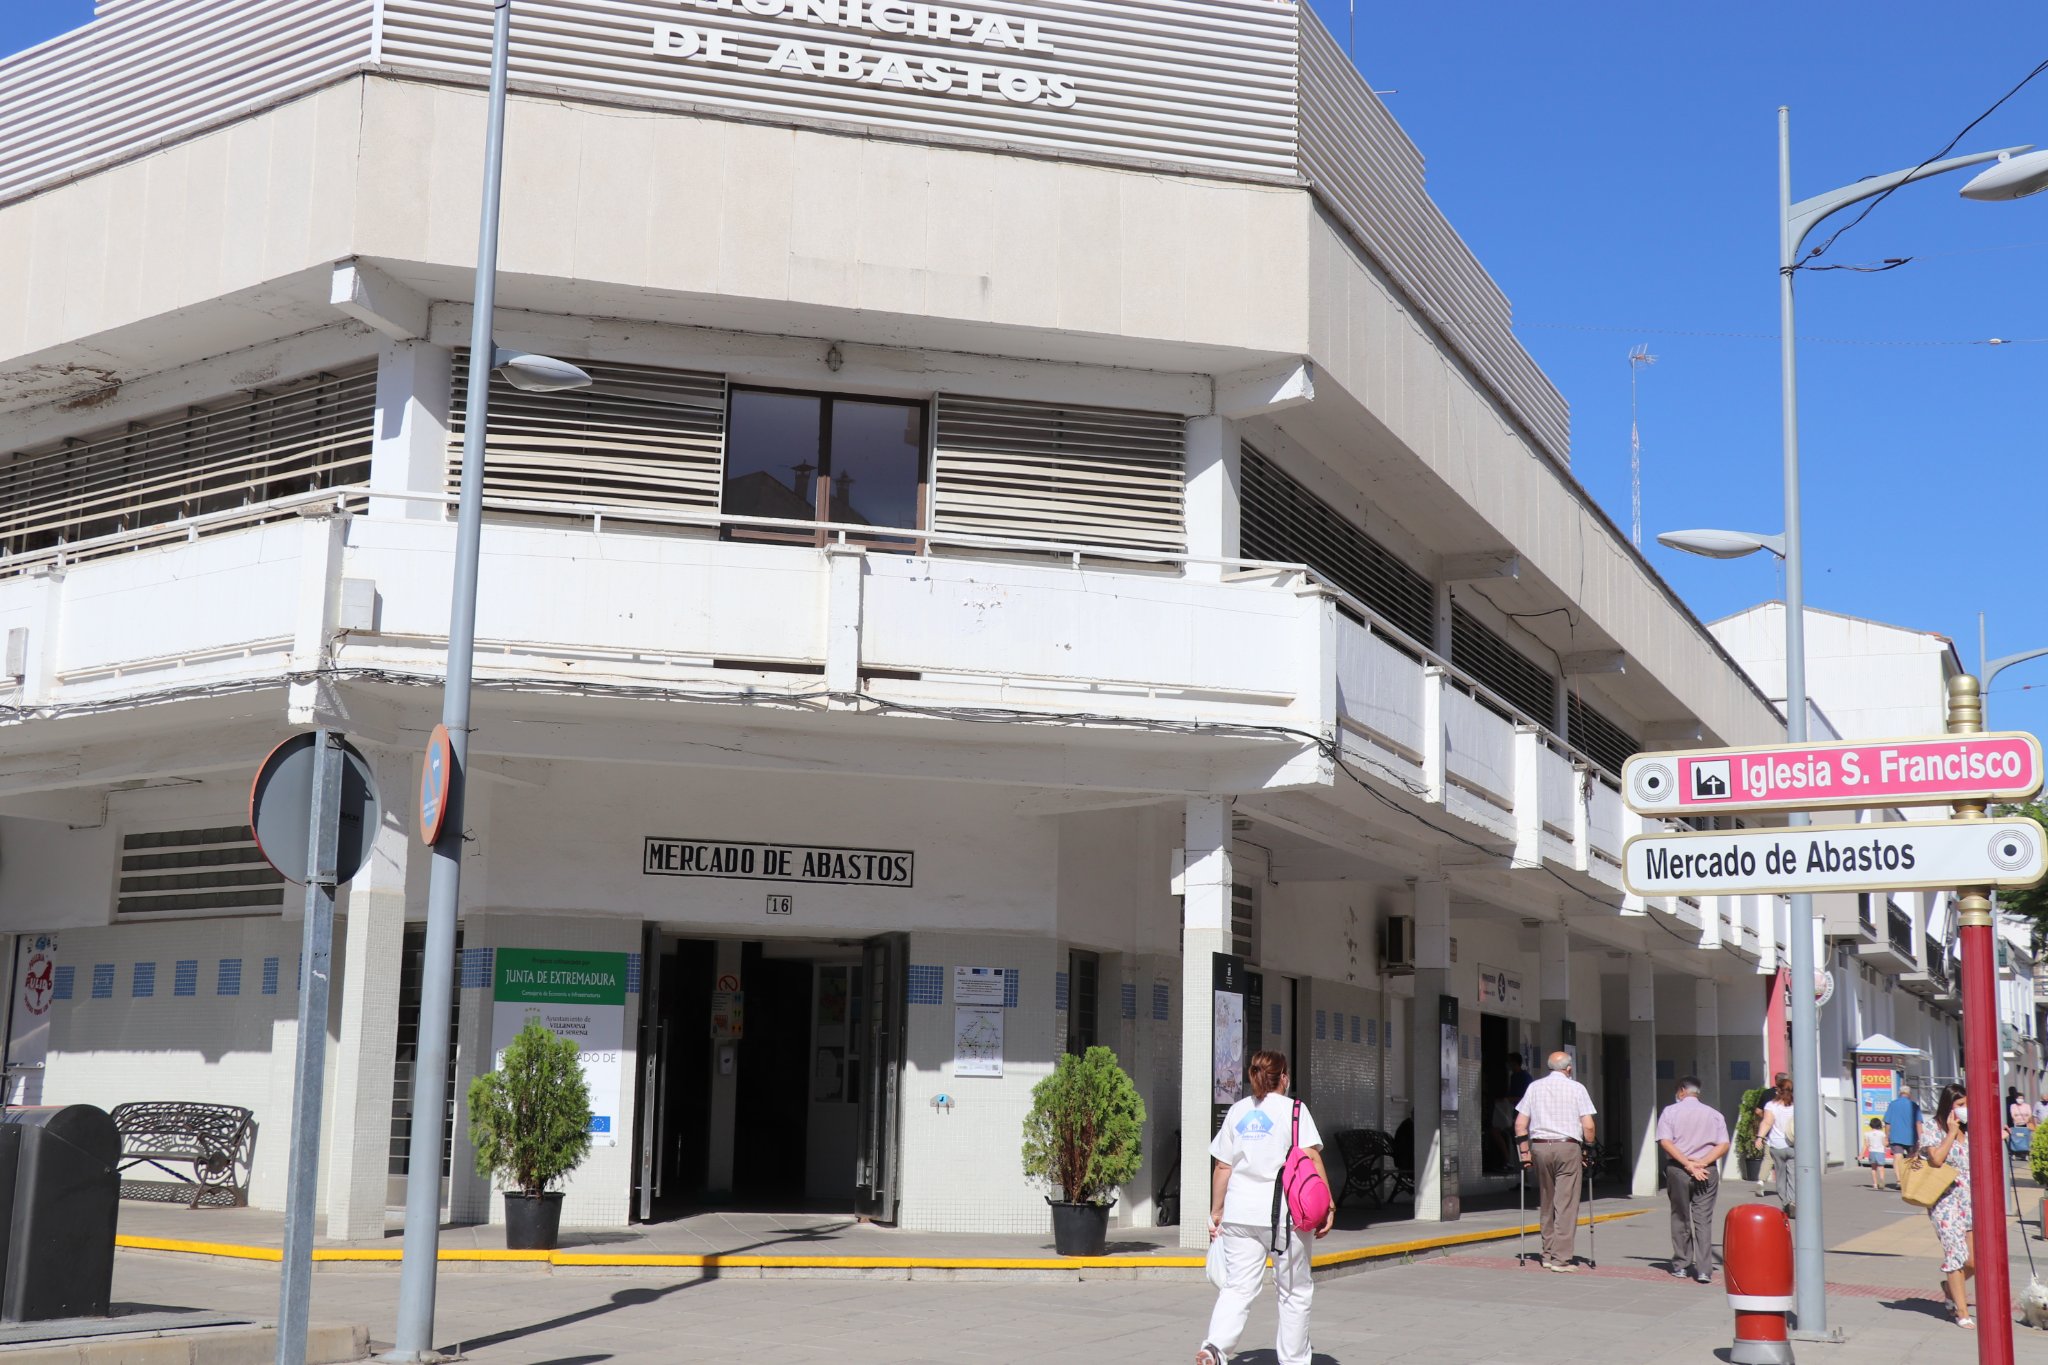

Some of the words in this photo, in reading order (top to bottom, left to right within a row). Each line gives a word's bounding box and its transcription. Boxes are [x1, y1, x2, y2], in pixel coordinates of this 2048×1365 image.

[680, 0, 1053, 53] UNICIPAL
[653, 20, 738, 65] DE
[765, 39, 1076, 107] ABASTOS
[1741, 755, 1832, 797] Iglesia
[1841, 752, 1870, 785] S.
[1880, 745, 2022, 783] Francisco
[649, 843, 755, 874] MERCADO
[763, 850, 792, 876] DE
[802, 851, 907, 882] ABASTOS
[1646, 844, 1755, 880] Mercado
[1766, 842, 1796, 875] de
[1806, 838, 1915, 873] Abastos
[772, 898, 789, 912] 16
[505, 969, 534, 985] JUNTA
[537, 970, 548, 984] DE
[550, 971, 616, 987] EXTREMADURA
[546, 1015, 583, 1023] Ayuntamiento
[602, 1053, 616, 1063] DE
[1861, 1075, 1891, 1083] FOTOS
